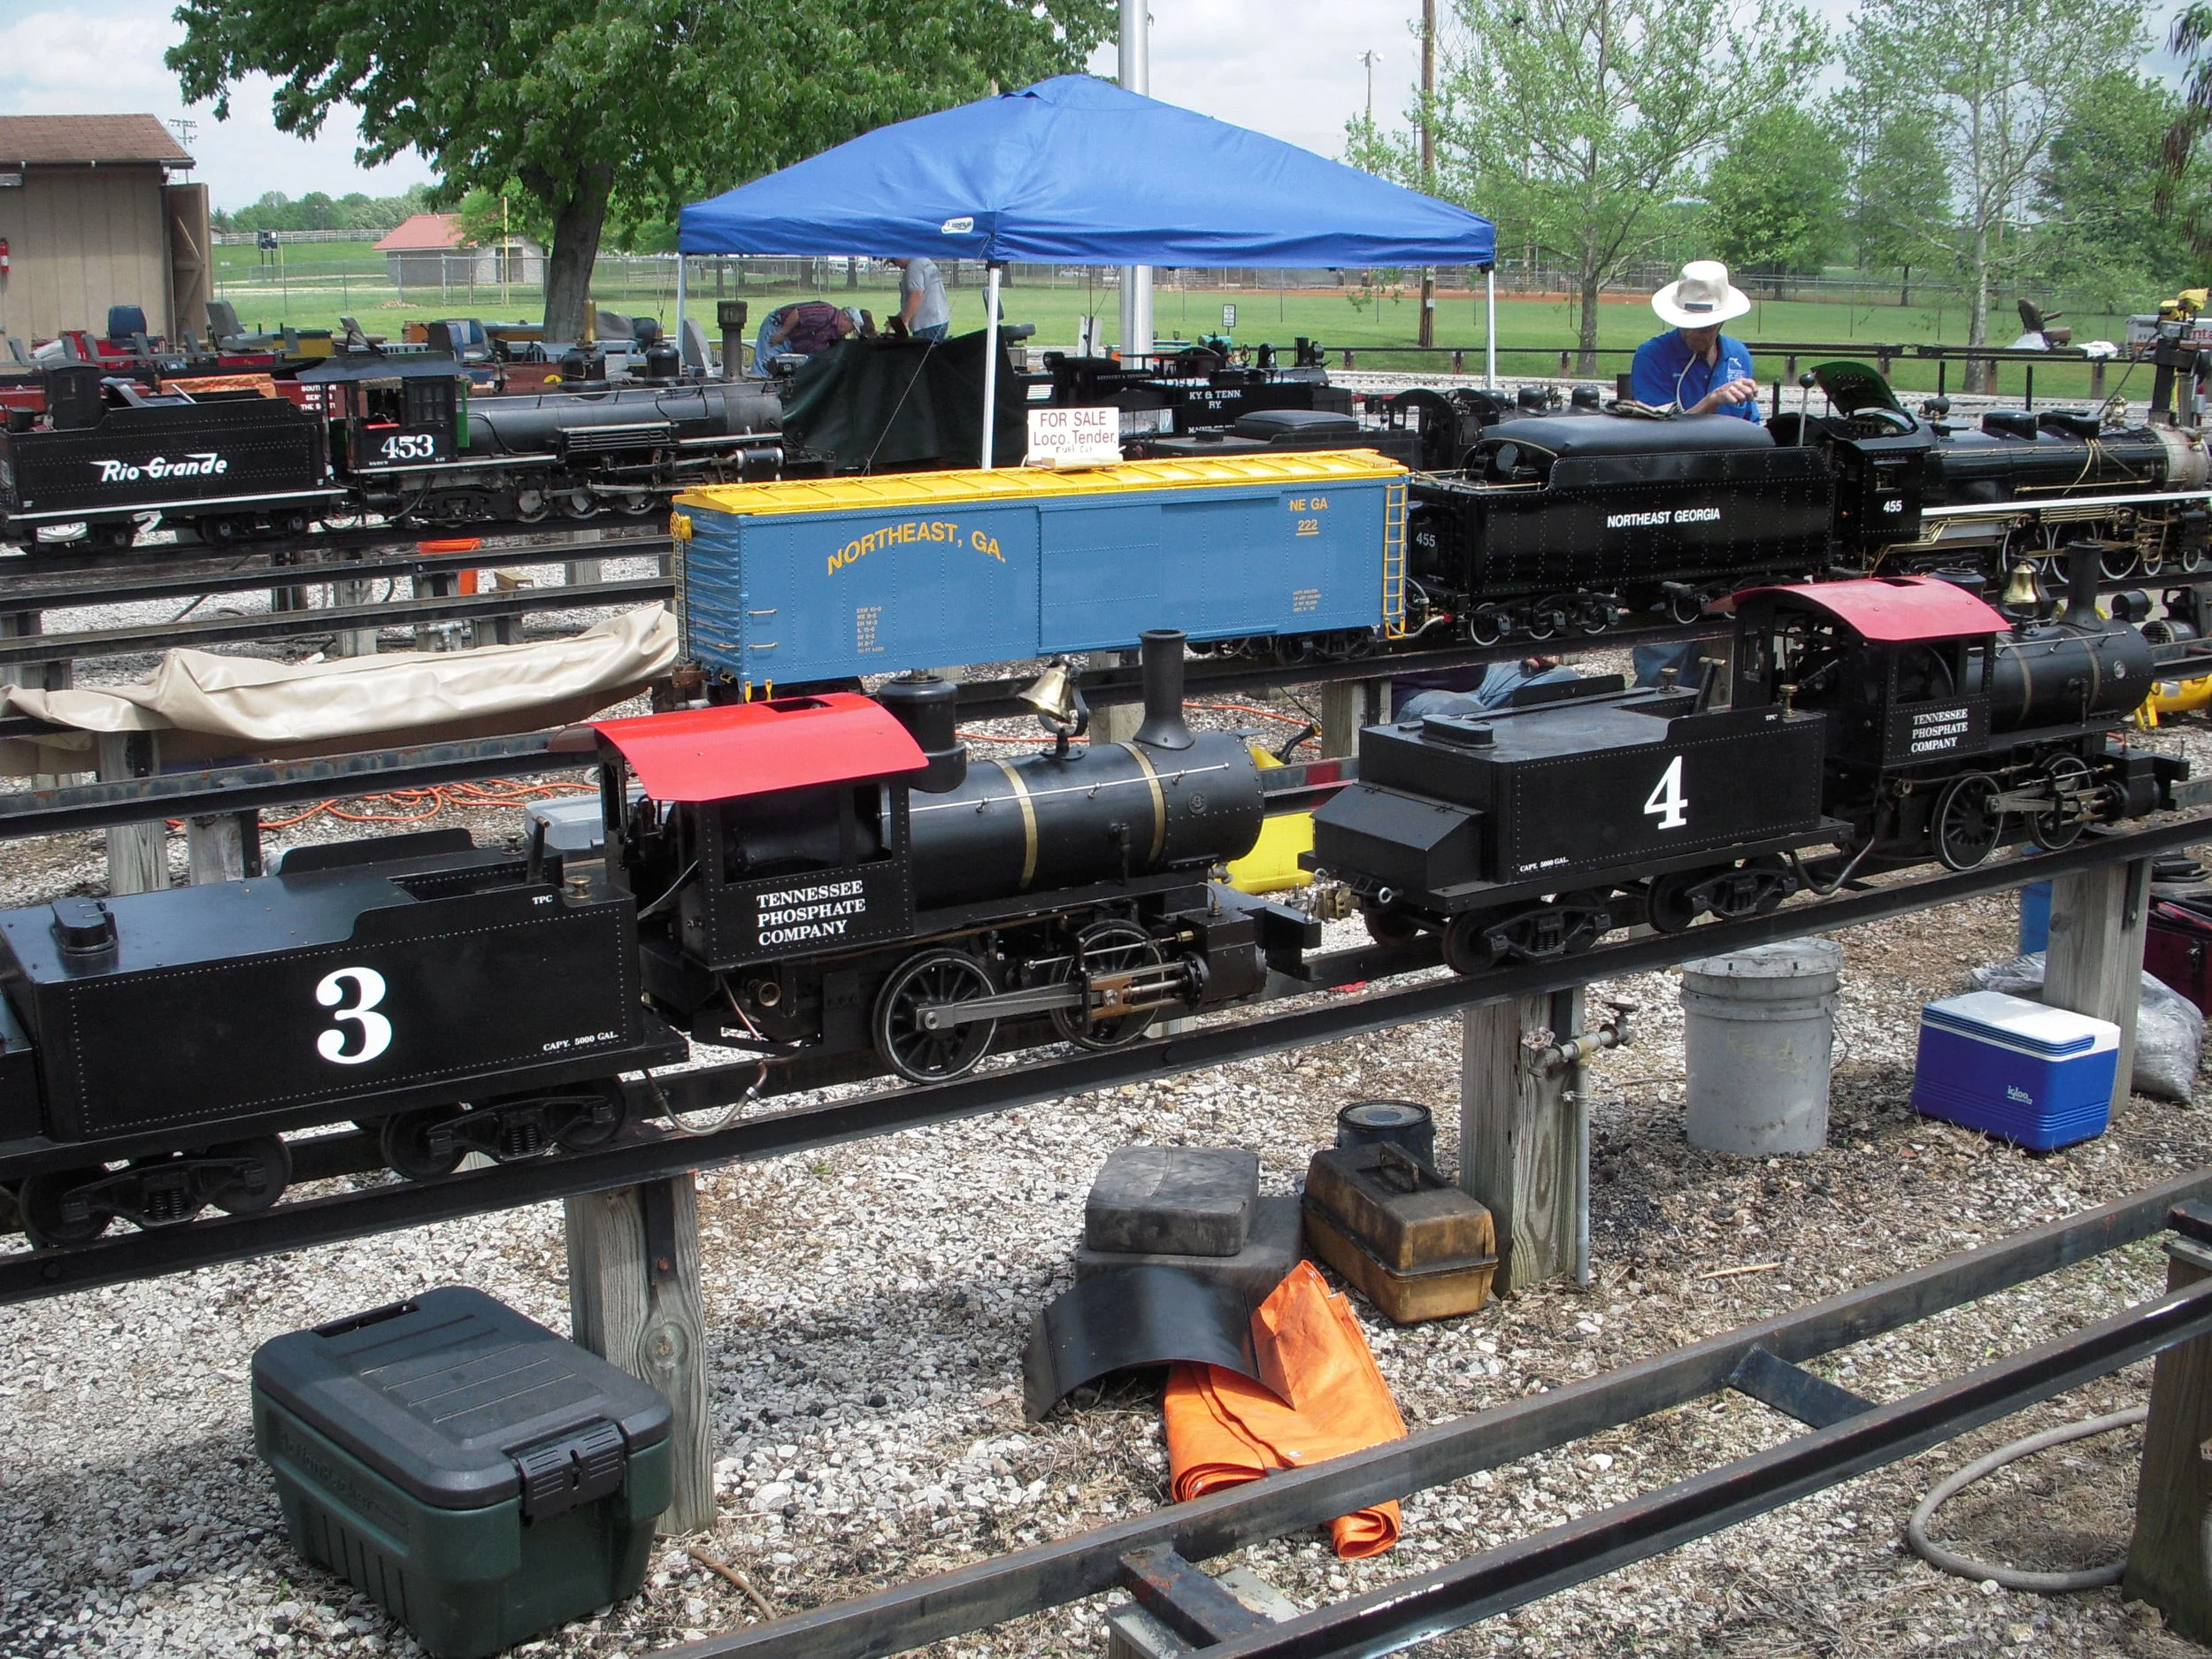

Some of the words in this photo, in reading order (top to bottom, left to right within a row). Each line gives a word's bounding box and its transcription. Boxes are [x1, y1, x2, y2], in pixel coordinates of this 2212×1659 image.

[1041, 412, 1067, 427] FOR
[1074, 411, 1107, 426] SALE
[380, 434, 434, 459] 453
[89, 460, 141, 482] Rio
[138, 453, 228, 479] Grande
[1289, 498, 1307, 511] NE
[1310, 496, 1328, 511] GA
[1883, 500, 1902, 513] 455
[1298, 519, 1318, 531] 222
[1607, 511, 1671, 528] NORTHEAST
[1674, 507, 1721, 523] GEORGIA
[827, 521, 963, 575] NORTHEAST,
[972, 530, 1006, 563] GA.
[1417, 532, 1436, 548] 455
[1912, 708, 1969, 726] TENNESSEE
[1911, 721, 1969, 740] PHOSPHATE
[1910, 736, 1958, 753] COMPANY
[1644, 756, 1688, 829] 4
[532, 895, 553, 905] TPC
[757, 880, 864, 908] TENNESSEE
[757, 898, 866, 927] PHOSPHATE
[758, 919, 848, 946] COMPANY
[316, 966, 392, 1064] 3
[574, 1034, 595, 1047] 5000
[596, 1030, 619, 1041] GAL.
[2007, 1085, 2030, 1099] igloo
